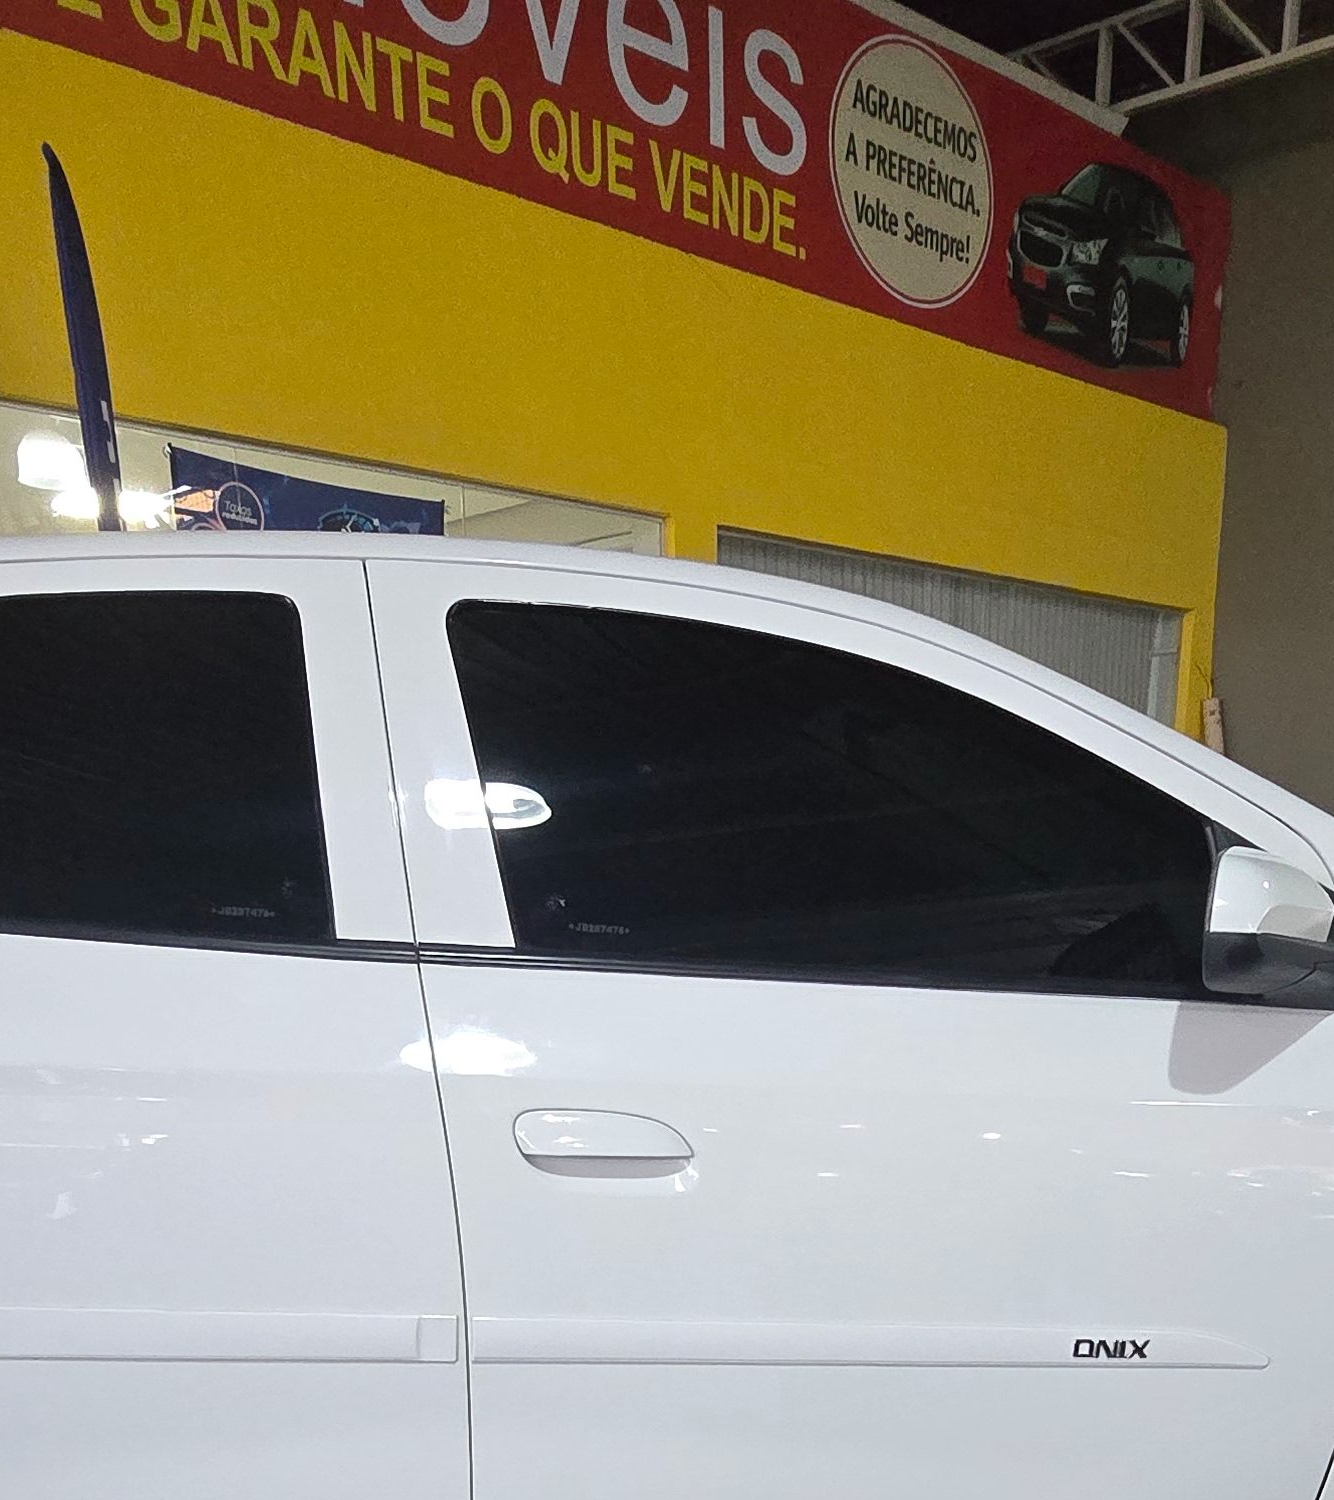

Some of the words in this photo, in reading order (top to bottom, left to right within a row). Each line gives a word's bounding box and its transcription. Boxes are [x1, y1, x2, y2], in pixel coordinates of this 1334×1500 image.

[402, 0, 808, 177] veis
[851, 78, 978, 163] AGRADECEMOS
[471, 76, 513, 154] O
[529, 98, 637, 201] QUE
[649, 138, 807, 261] VENDE.
[845, 132, 859, 166] A
[865, 138, 981, 217] PREFERÊNCIA.
[853, 190, 899, 236] Volte
[903, 211, 971, 265] Sempre!
[1072, 1338, 1151, 1359] ONIX
